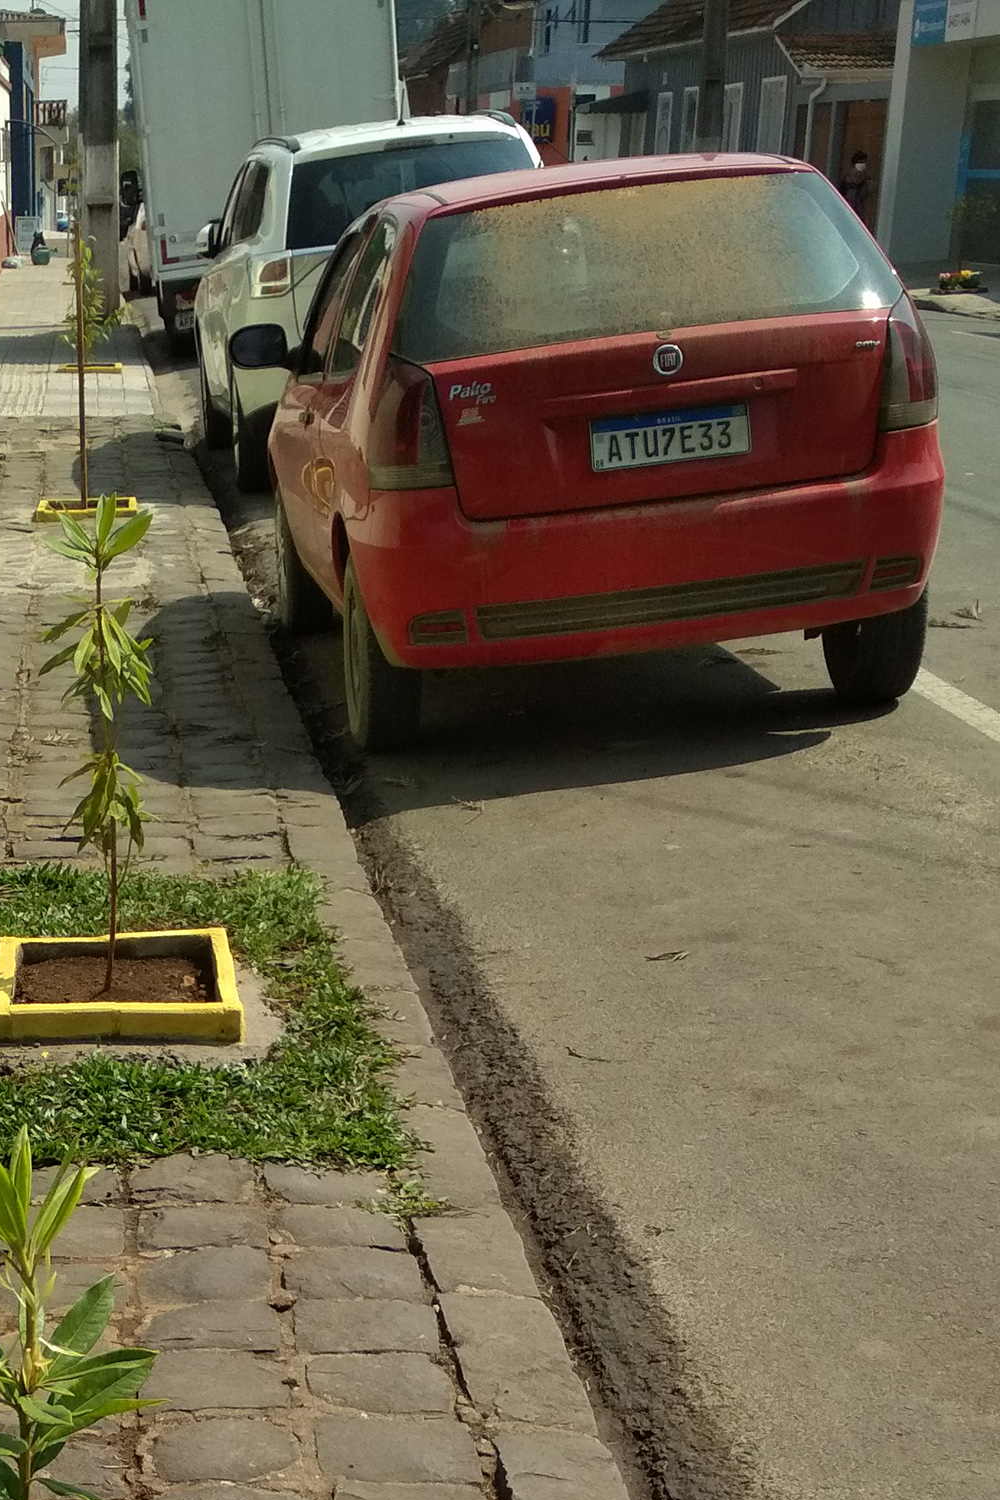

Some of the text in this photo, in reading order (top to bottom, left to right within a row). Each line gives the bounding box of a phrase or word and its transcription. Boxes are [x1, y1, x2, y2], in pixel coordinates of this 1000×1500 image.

[660, 352, 677, 368] FIAT
[449, 380, 492, 401] Palio
[656, 416, 682, 424] BRASIL
[608, 420, 732, 462] ATU7E33
